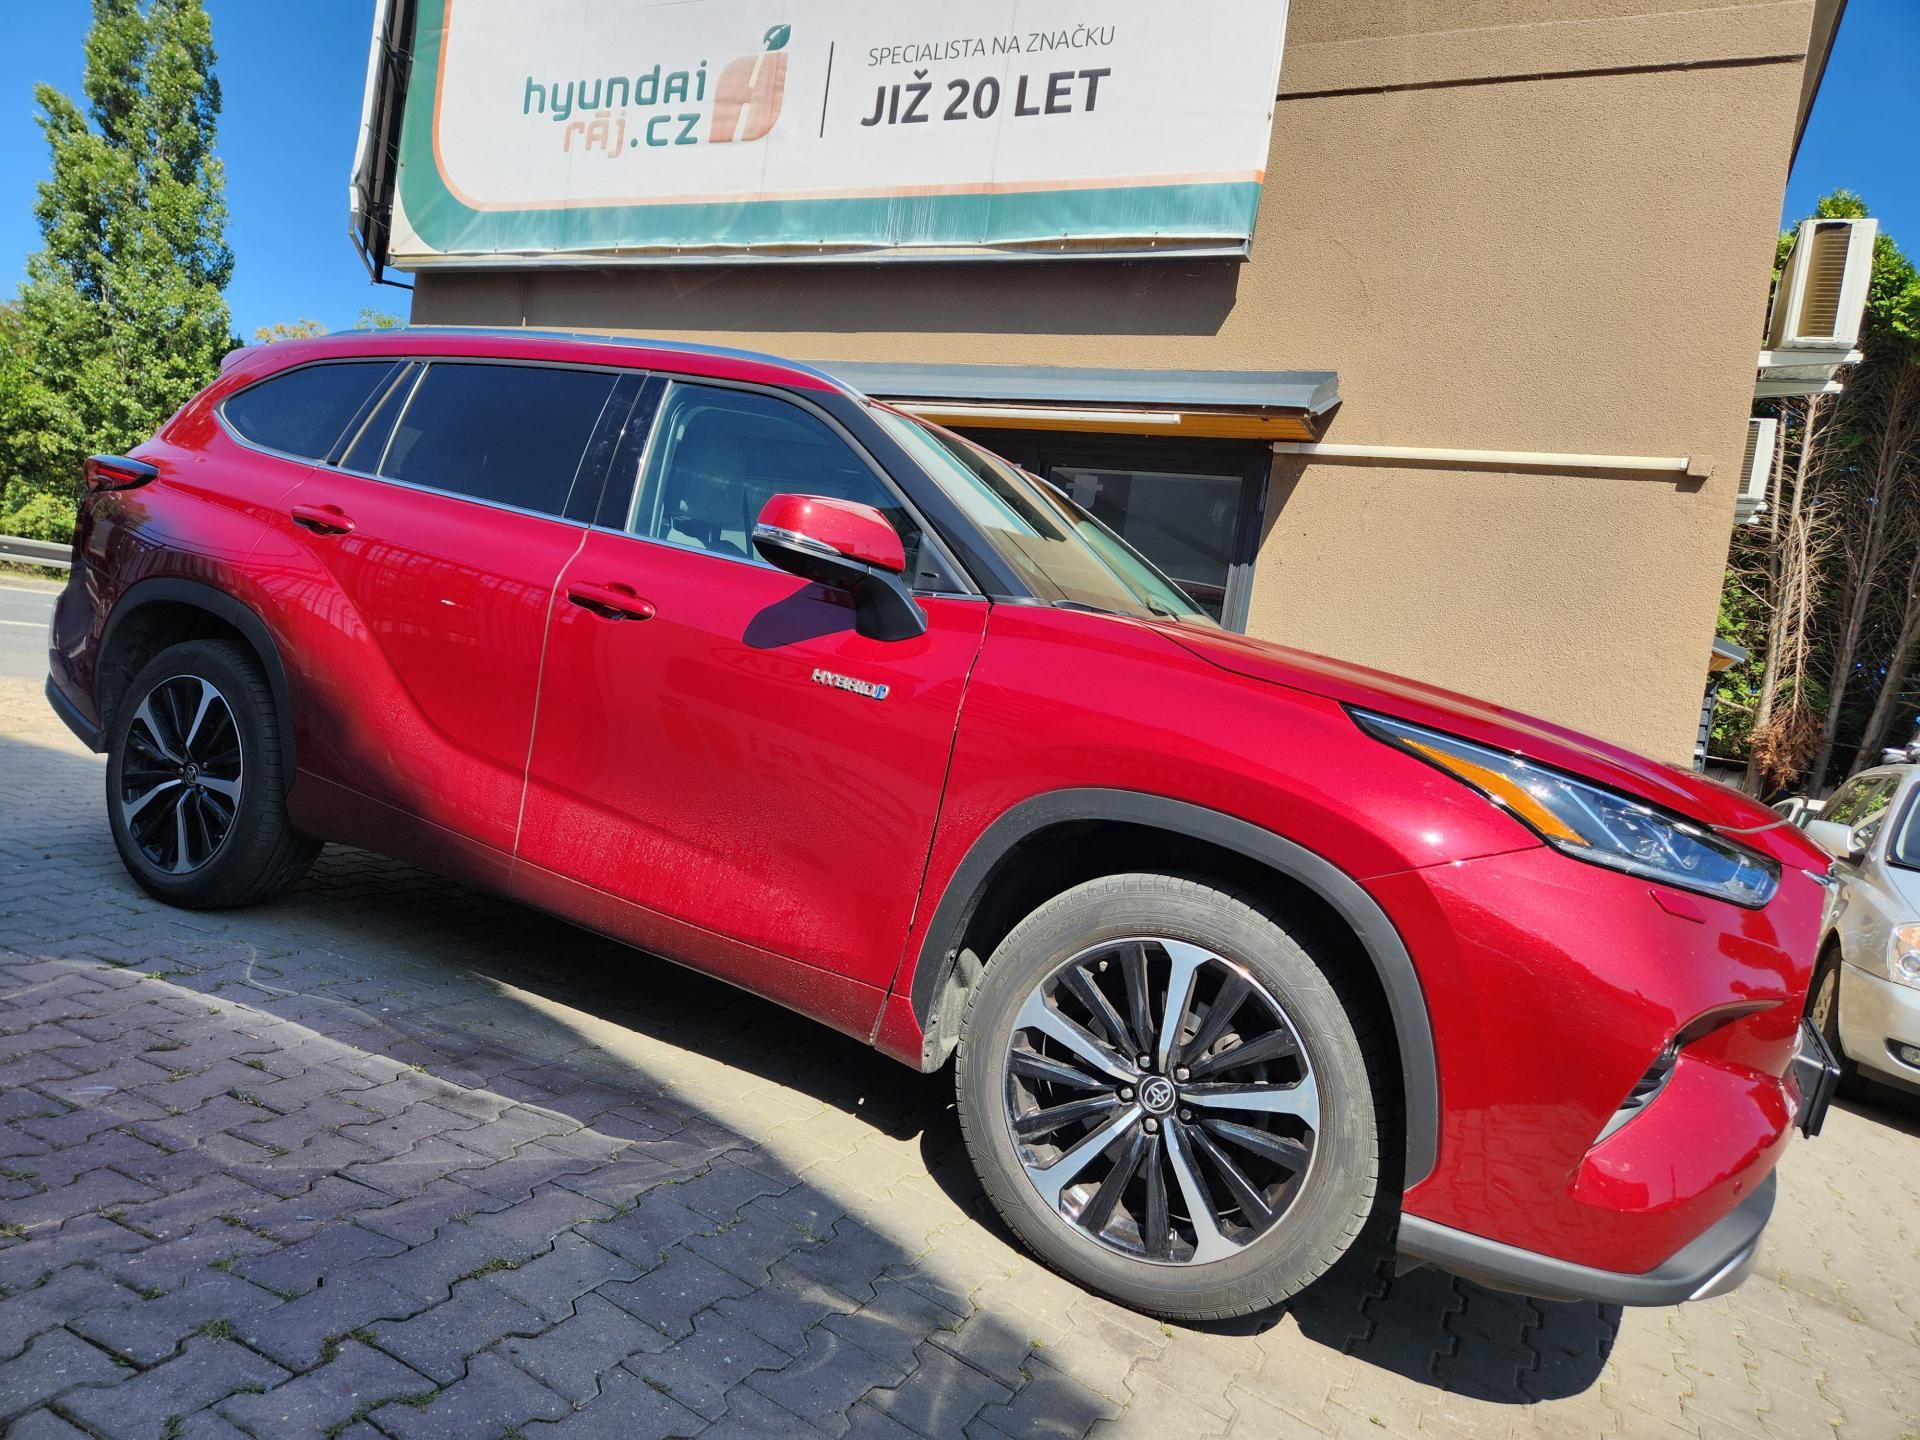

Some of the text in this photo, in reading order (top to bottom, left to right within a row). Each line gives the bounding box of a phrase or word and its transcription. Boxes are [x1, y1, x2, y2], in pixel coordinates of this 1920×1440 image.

[867, 23, 1115, 66] SPECIALISTA NA ZNAČKU
[860, 67, 1111, 126] JIŽ 20 LET
[812, 668, 876, 697] HYBRID
